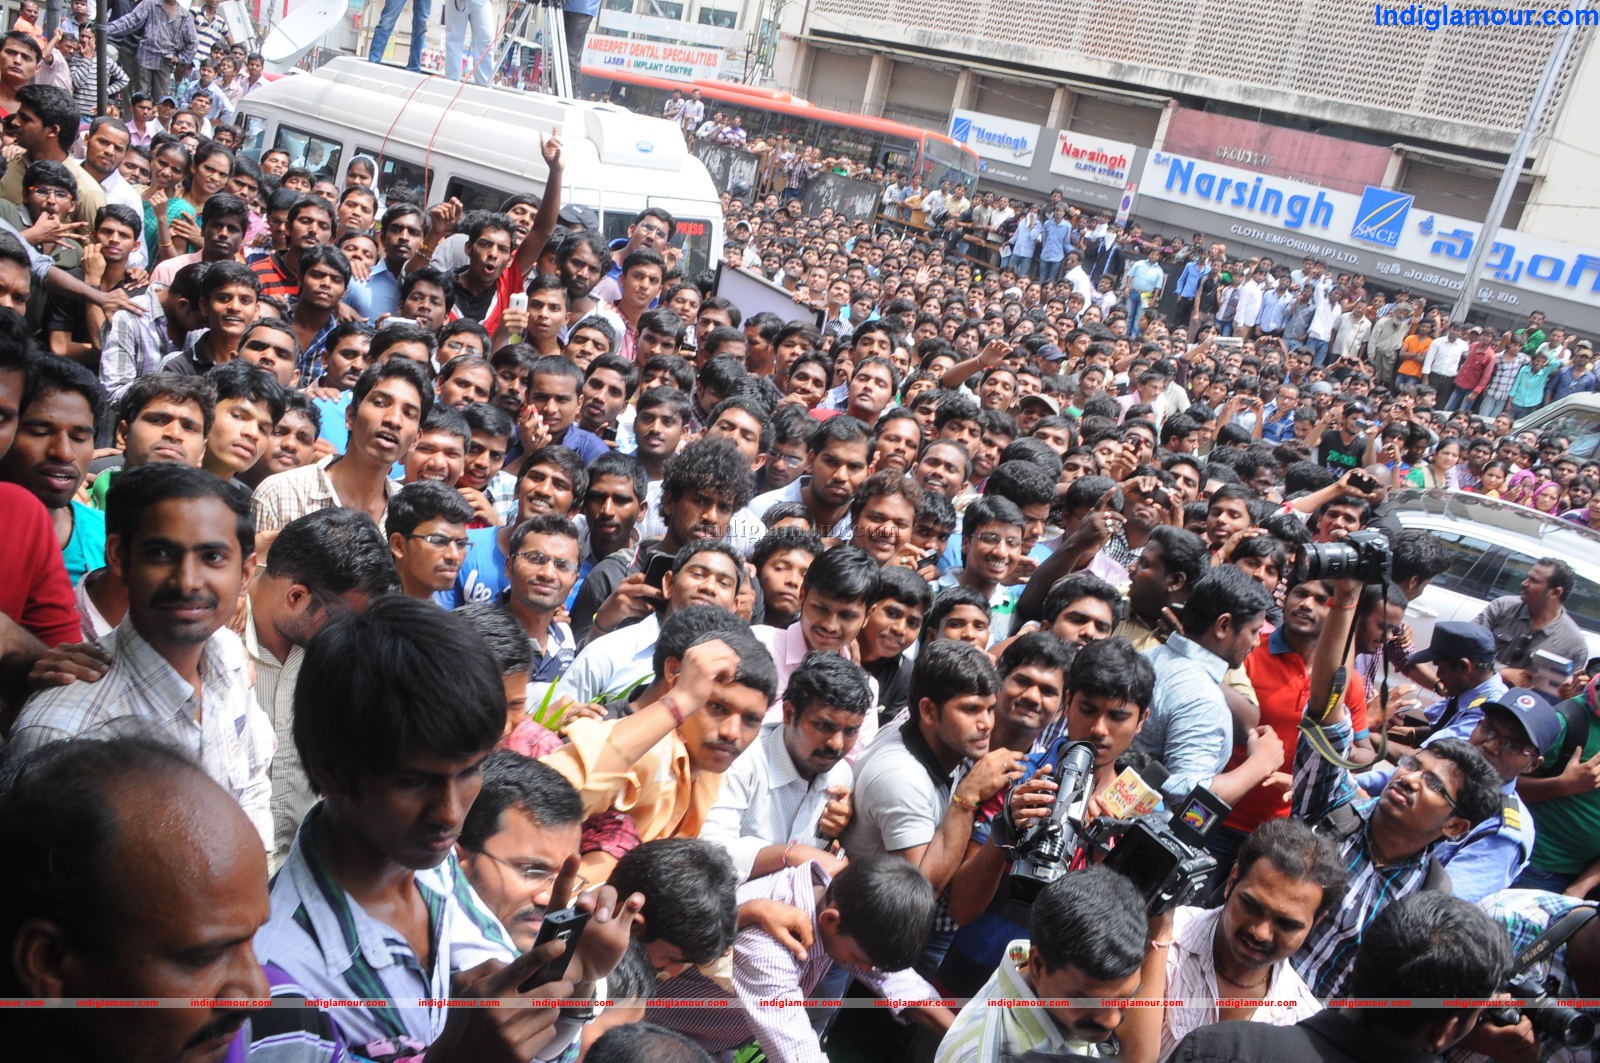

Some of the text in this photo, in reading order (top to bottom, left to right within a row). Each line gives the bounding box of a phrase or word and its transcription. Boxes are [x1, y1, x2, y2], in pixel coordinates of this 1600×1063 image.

[587, 38, 718, 67] AMEERPET DENTAL SPECIALITIES
[604, 55, 693, 76] LASER & IMPLANT CENTRE
[976, 126, 1028, 150] Narsingh
[1061, 142, 1127, 169] Narsingh
[1075, 162, 1124, 179] CLOTH STORES
[1165, 158, 1335, 229] Narsingh
[675, 222, 705, 236] PRESS
[1230, 224, 1360, 265] CLOTH EMPORIUM (P) LTD.
